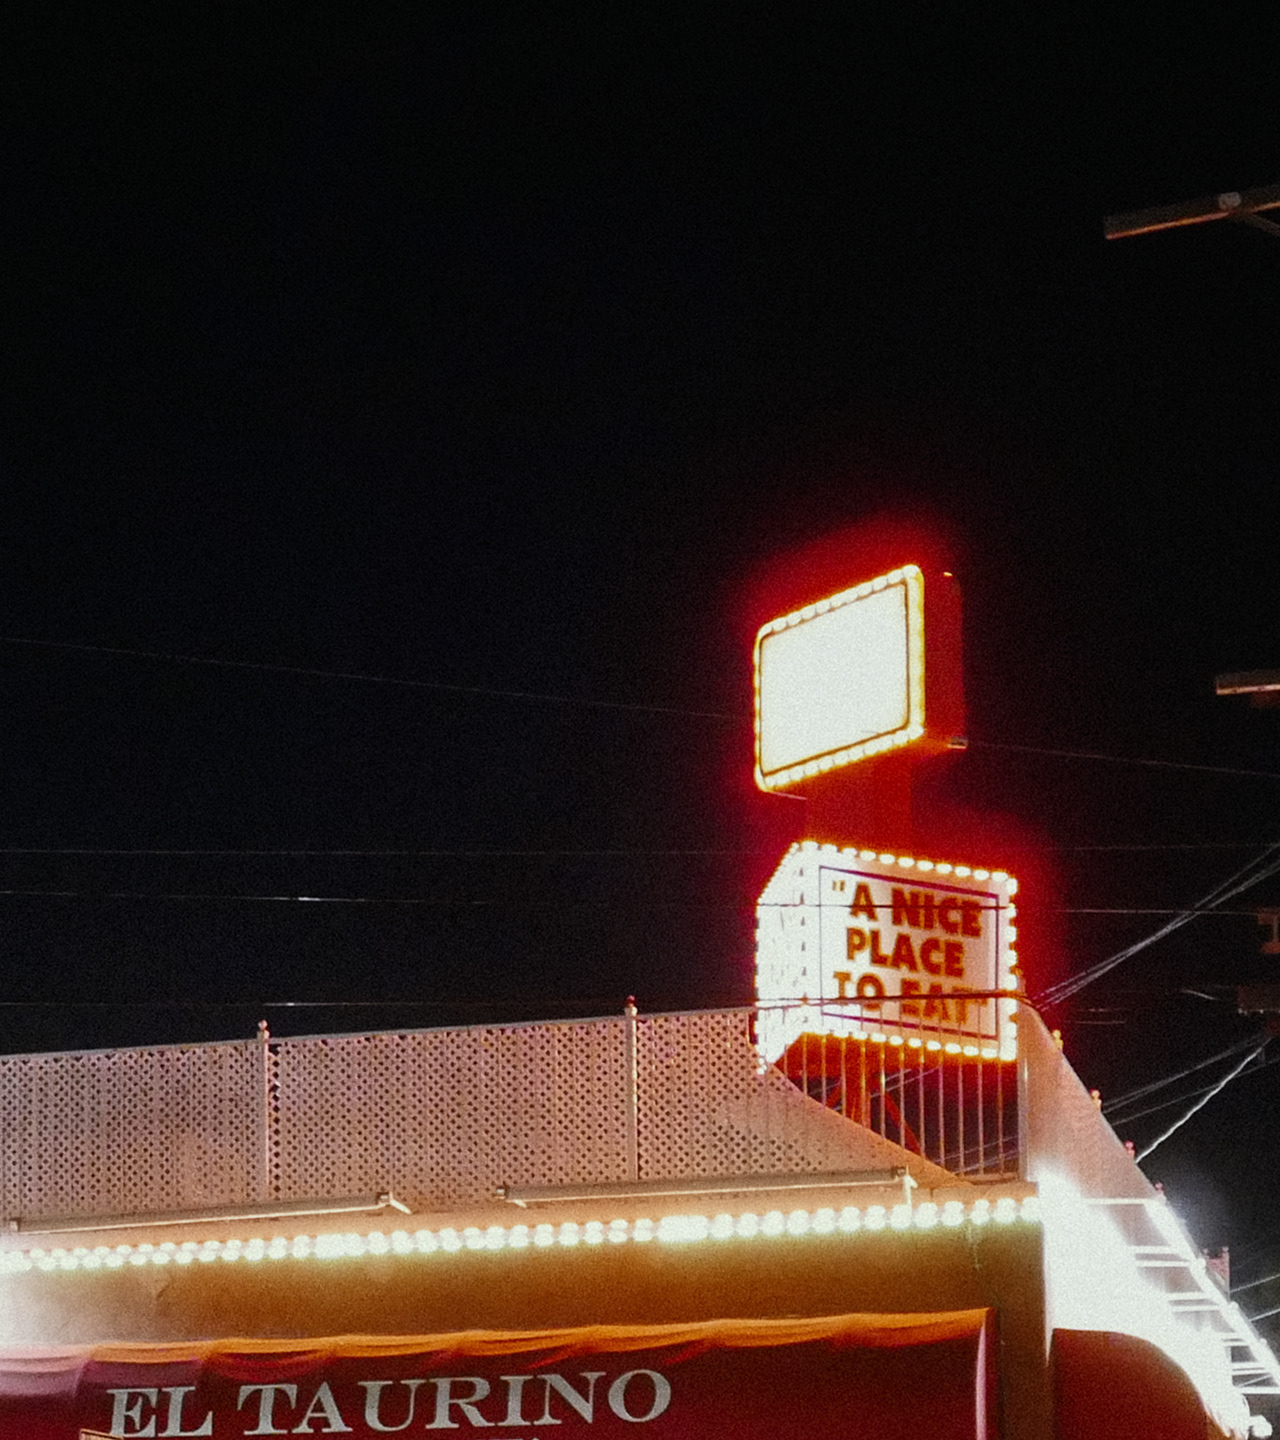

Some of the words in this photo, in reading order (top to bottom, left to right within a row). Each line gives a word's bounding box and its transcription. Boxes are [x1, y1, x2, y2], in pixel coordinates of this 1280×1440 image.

[890, 886, 982, 939] NICE
[846, 927, 965, 977] PLACE
[832, 970, 886, 1012] TO
[105, 1385, 214, 1439] EL
[236, 1368, 673, 1437] TAURINO
